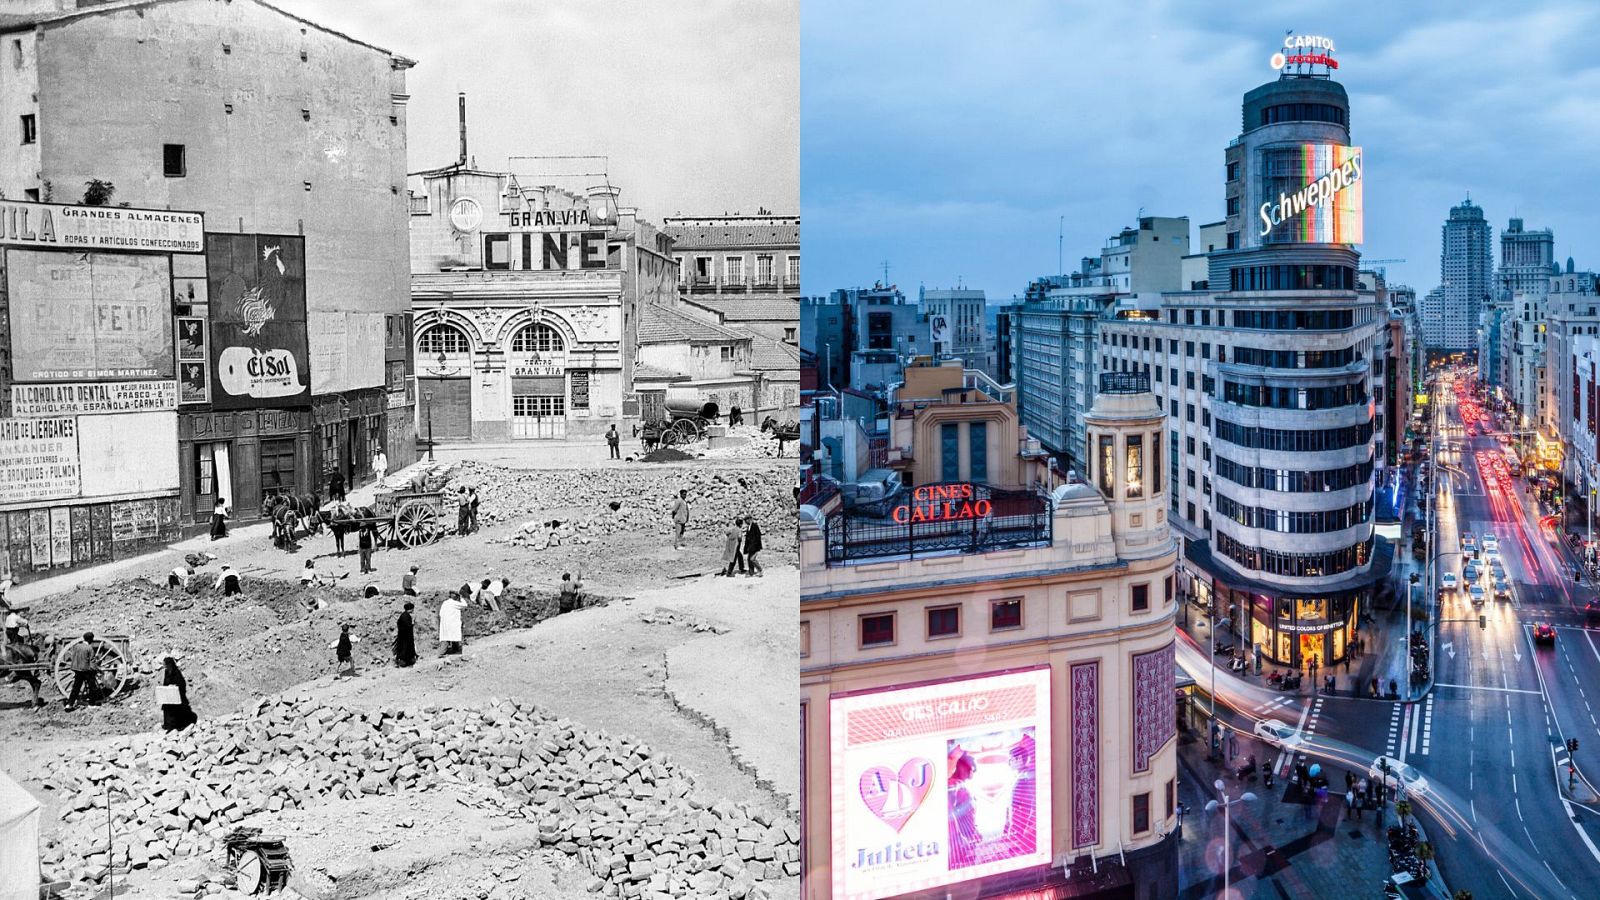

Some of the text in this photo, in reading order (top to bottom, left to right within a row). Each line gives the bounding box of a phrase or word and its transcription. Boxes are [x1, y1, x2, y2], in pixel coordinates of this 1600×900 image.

[1284, 35, 1336, 52] CAPITOL
[1260, 153, 1362, 237] Schweppes
[62, 206, 200, 225] GRANDES ALMACENES
[510, 209, 590, 227] GRAN VIA
[64, 235, 88, 244] ROPAS
[92, 236, 96, 244] Y
[141, 238, 200, 249] CONFECCIONADOS
[484, 232, 607, 270] CINE
[247, 355, 291, 377] El Sol
[514, 367, 561, 375] GRAN VIA
[15, 385, 111, 404] ALCOHOLATO DENTAL
[117, 391, 150, 399] FRASCO
[157, 390, 163, 398] 2
[167, 398, 174, 408] 10
[21, 423, 29, 438] DE
[31, 419, 73, 439] LIERGANES
[7, 467, 44, 482] BRONQUIOS
[913, 483, 973, 502] CINES
[892, 499, 992, 525] CALLAO
[1278, 620, 1344, 632] UNITED COLORS OF BENETTON
[937, 697, 989, 717] CALLAO
[866, 770, 888, 797] A
[911, 762, 930, 788] J
[851, 840, 940, 869] Julieta
